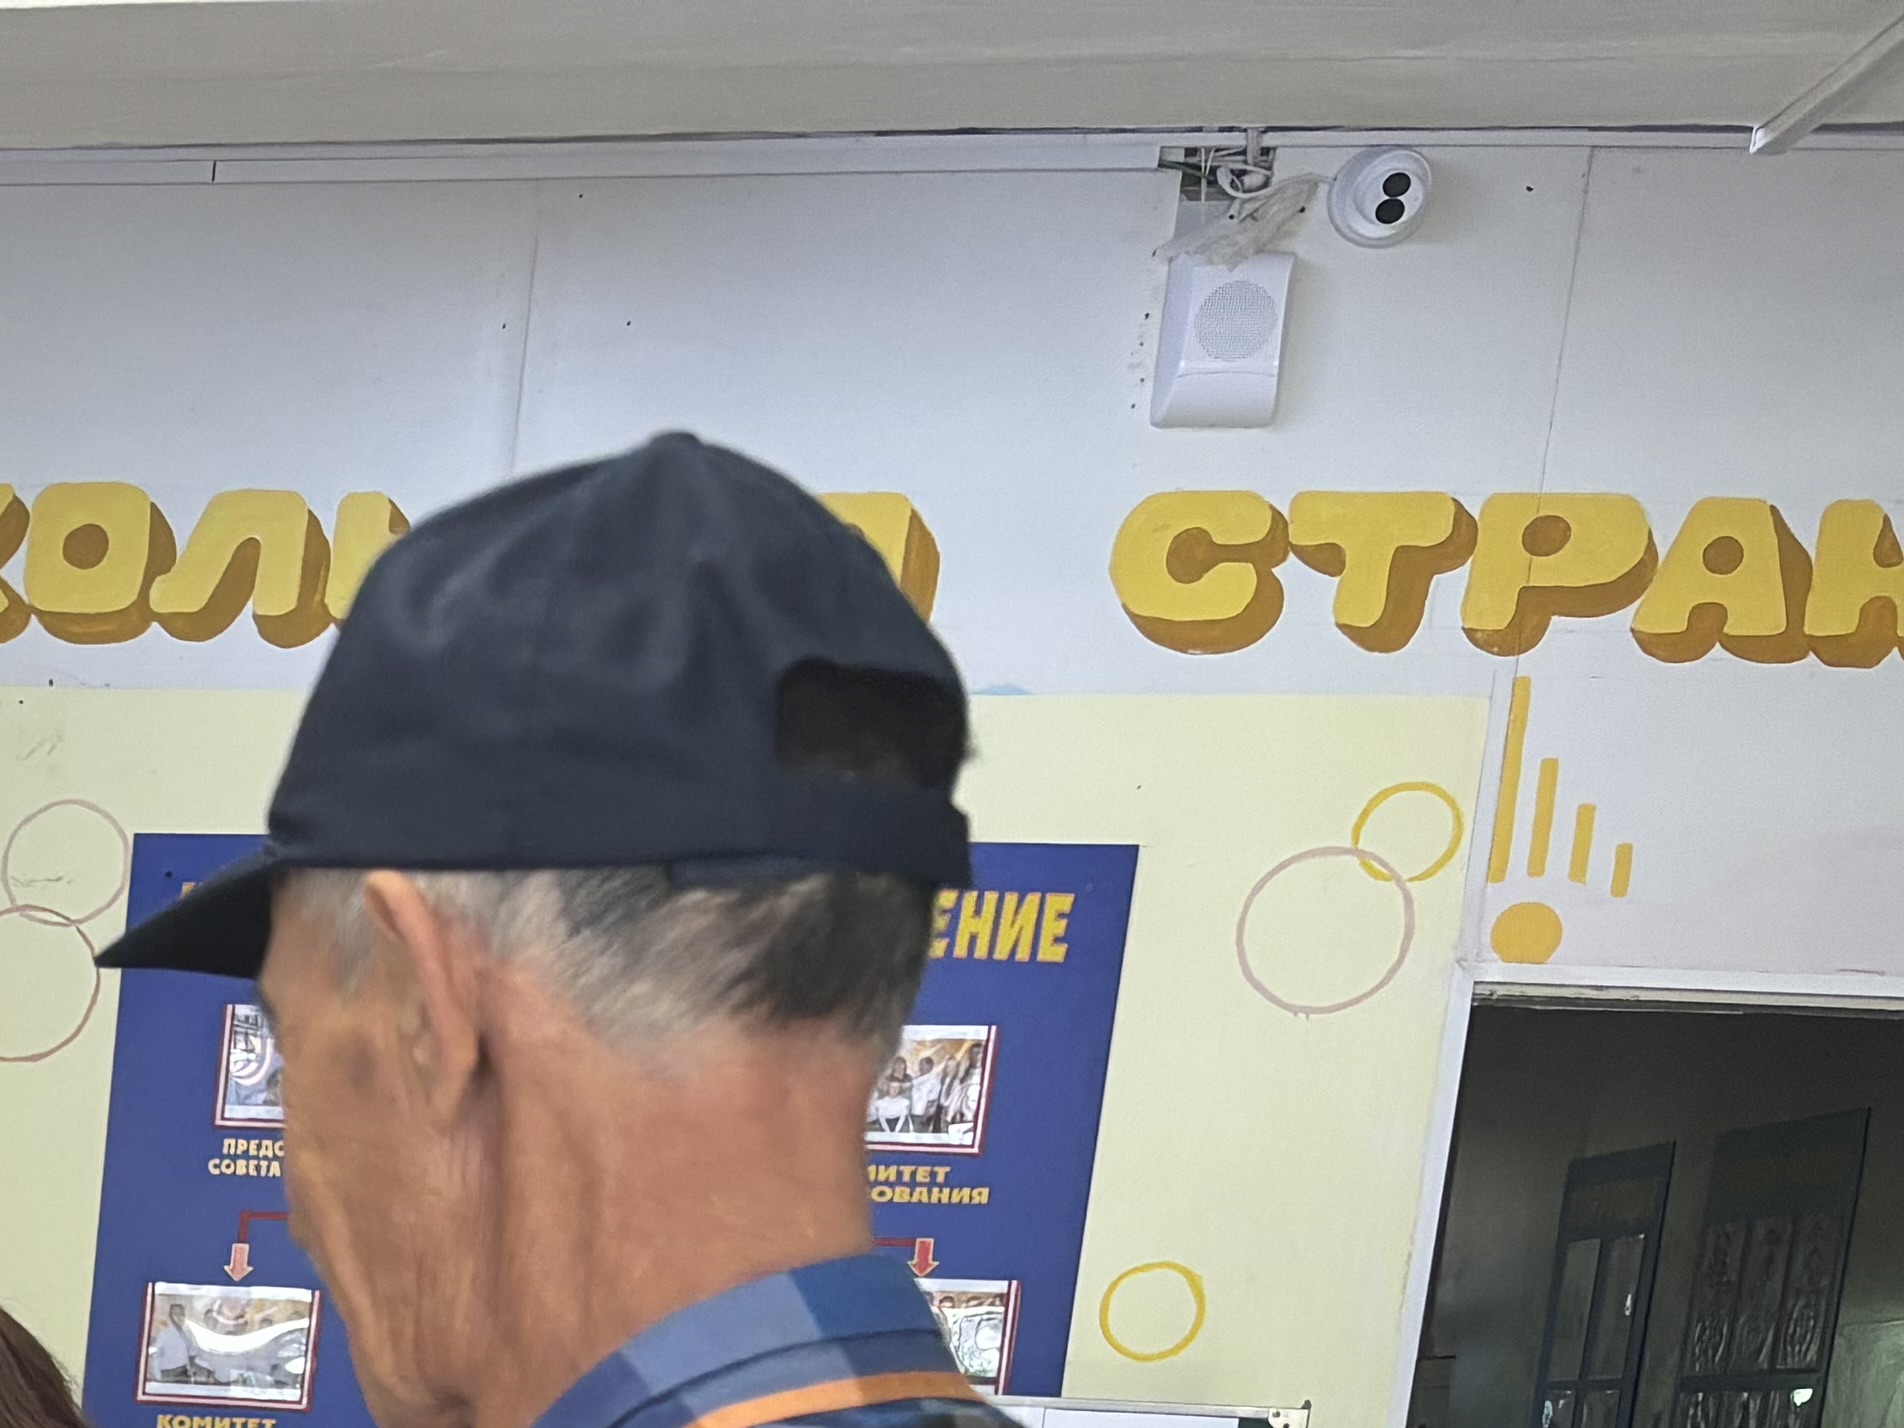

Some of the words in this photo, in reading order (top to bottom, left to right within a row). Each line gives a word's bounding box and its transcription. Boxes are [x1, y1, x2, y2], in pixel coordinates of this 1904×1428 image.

[1109, 490, 1904, 669] СТРАН
[929, 890, 1075, 963] ЕНИЕ
[222, 1138, 285, 1158] ПРЕДС
[208, 1158, 282, 1178] СОВЕТА
[868, 1165, 951, 1183] ИТЕТ
